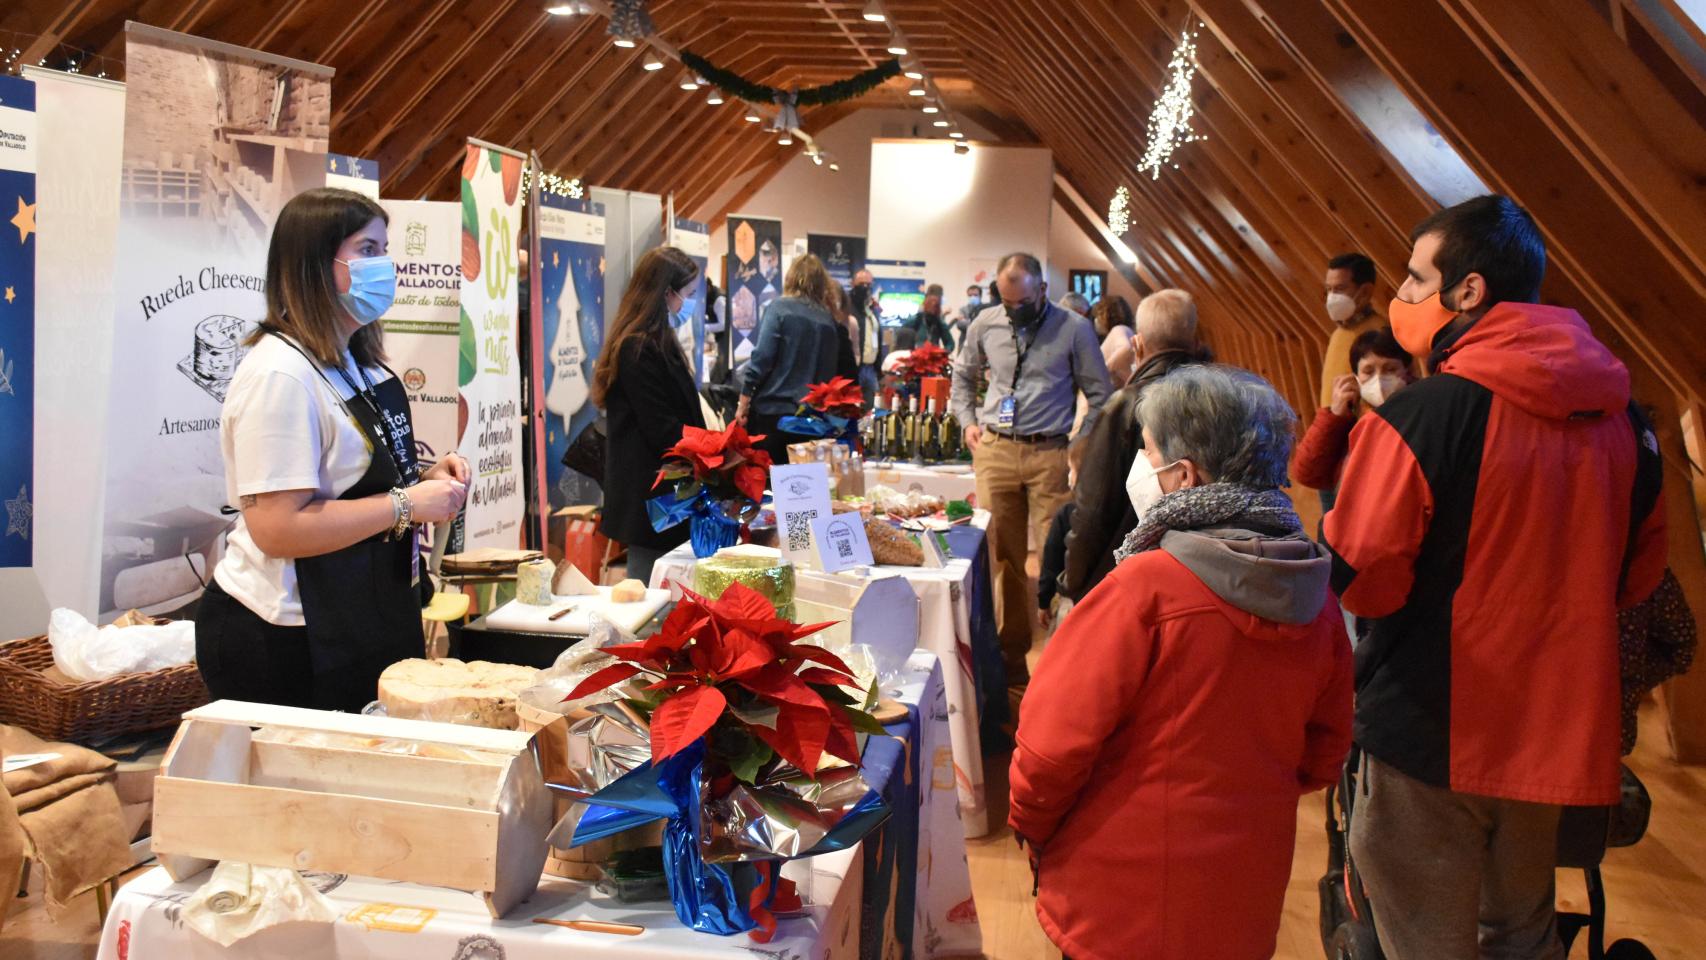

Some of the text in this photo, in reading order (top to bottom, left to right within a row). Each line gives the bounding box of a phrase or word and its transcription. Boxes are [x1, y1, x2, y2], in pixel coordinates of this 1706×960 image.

[392, 262, 462, 277] MENTOS
[140, 275, 195, 321] Rueda
[390, 294, 418, 307] usto
[418, 295, 432, 306] de
[478, 401, 485, 424] la
[159, 417, 220, 436] Artesanos
[471, 475, 517, 508] de Valladolid
